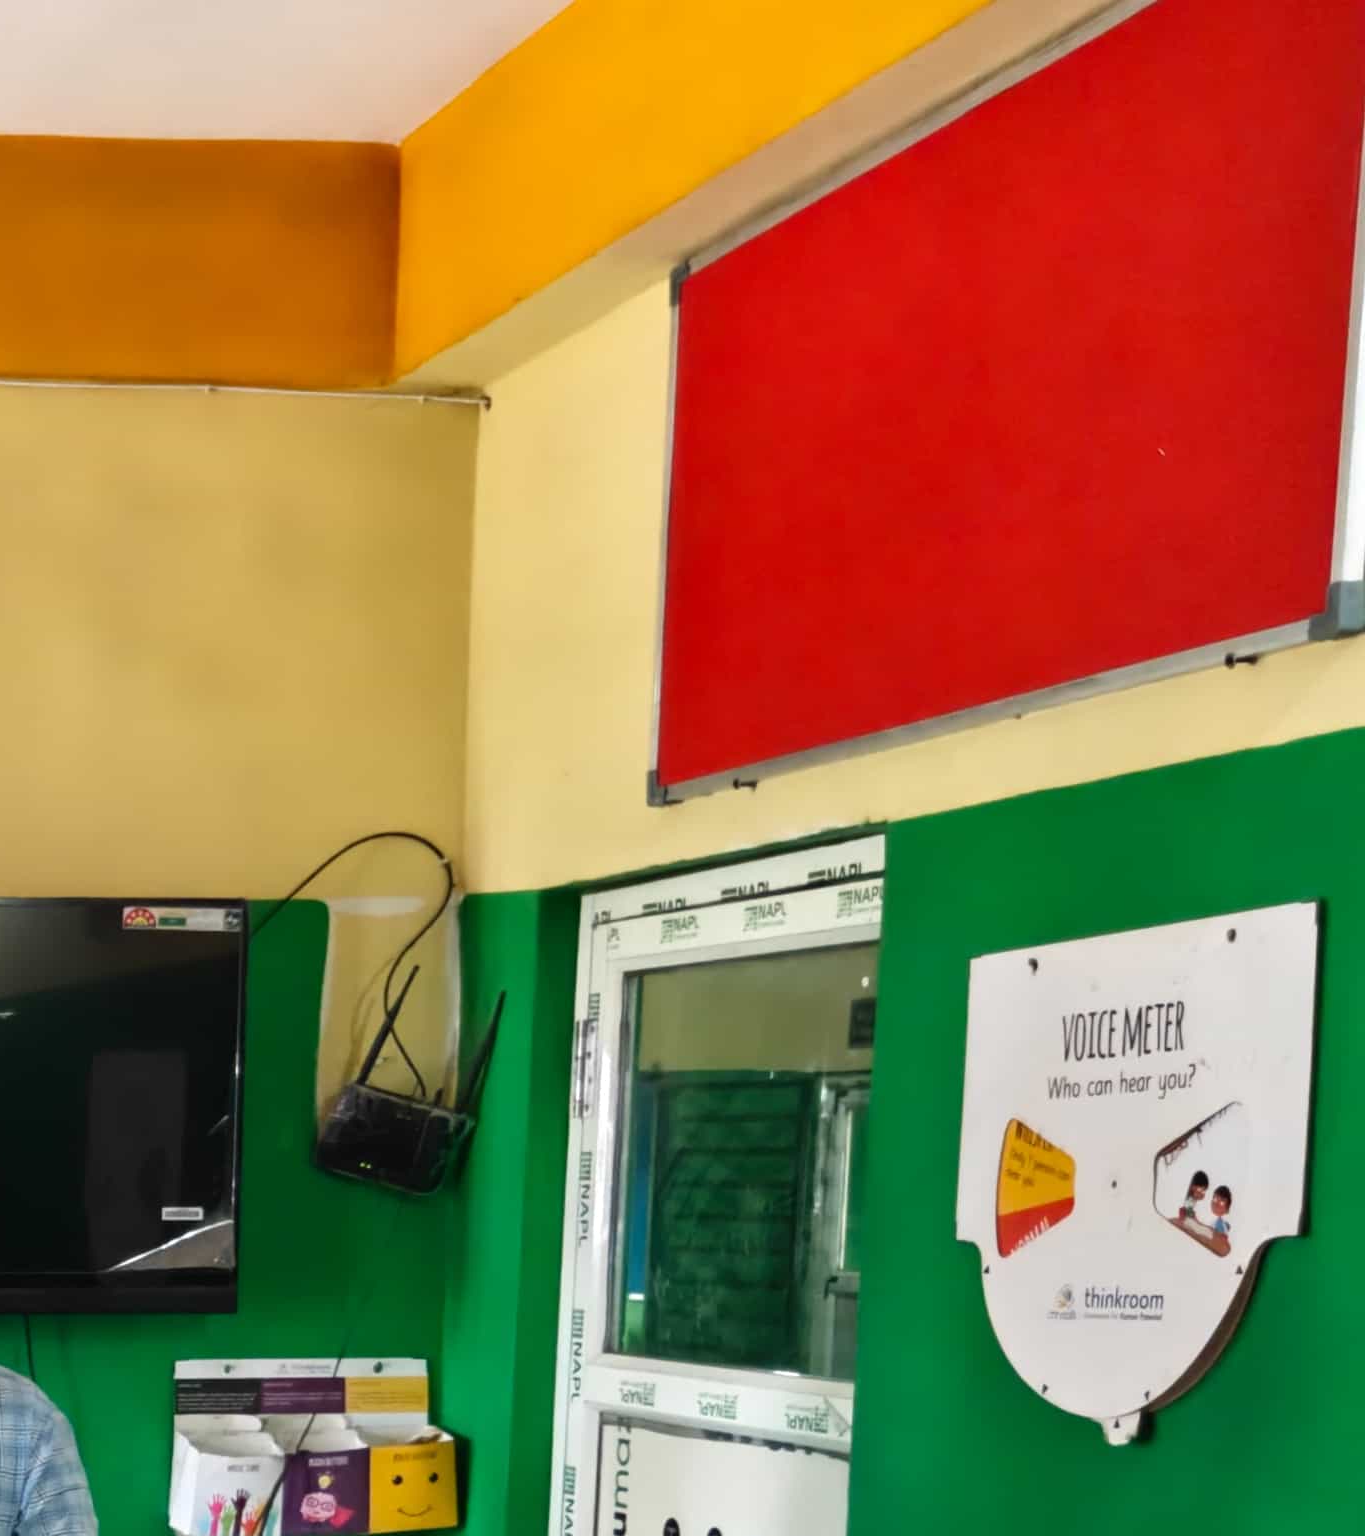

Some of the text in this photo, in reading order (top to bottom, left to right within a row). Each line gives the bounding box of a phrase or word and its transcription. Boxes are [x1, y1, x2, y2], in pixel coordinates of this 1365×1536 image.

[1062, 1000, 1185, 1062] VOICE METER
[1048, 1064, 1196, 1100] Who can hear you?
[1085, 1287, 1164, 1310] thinkroom
[571, 1341, 582, 1403] NAPL
